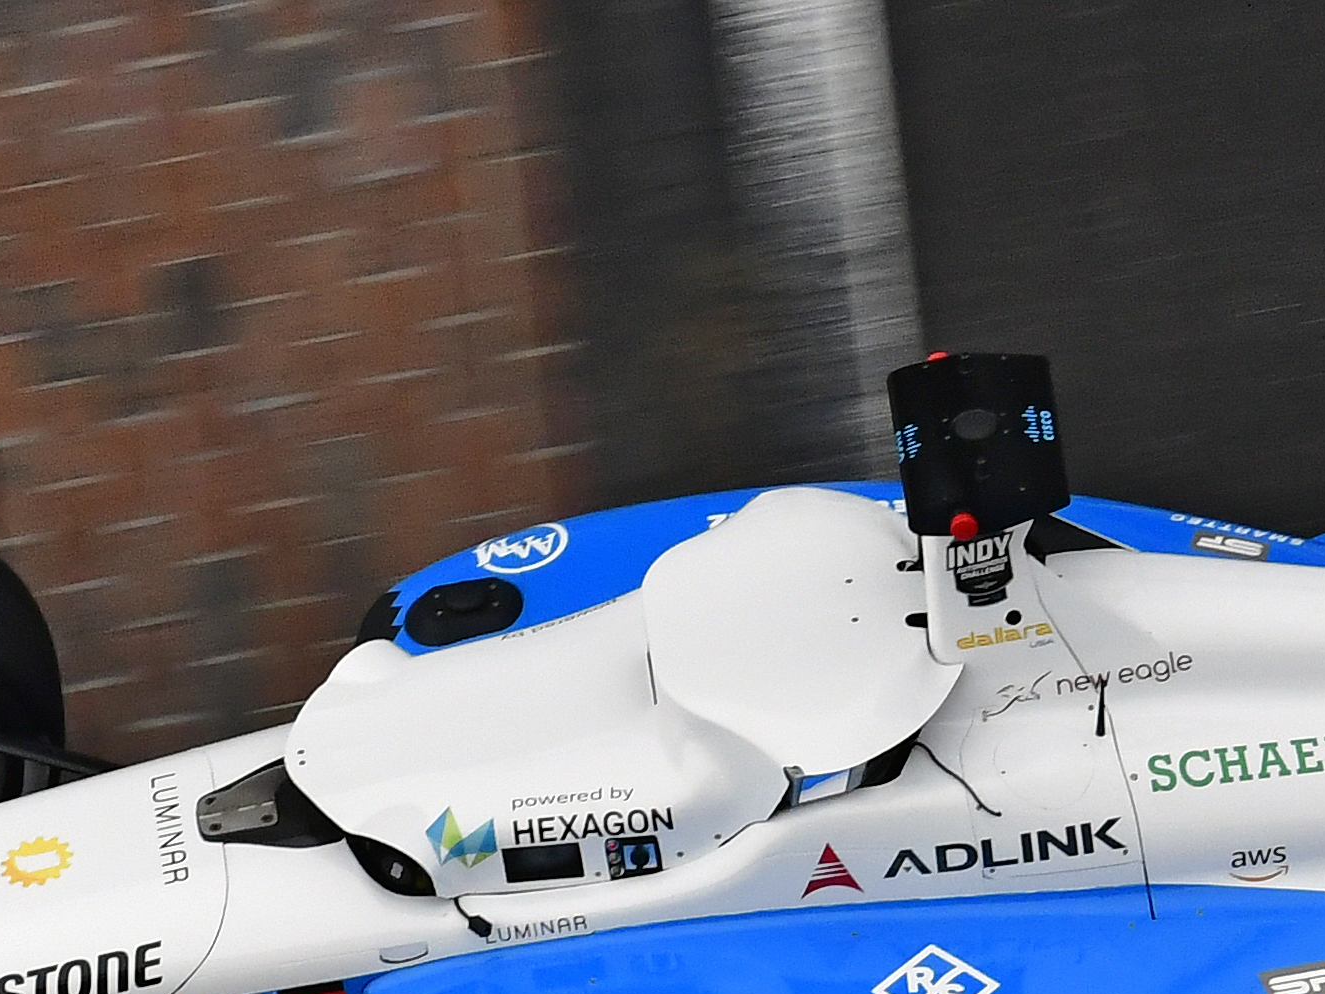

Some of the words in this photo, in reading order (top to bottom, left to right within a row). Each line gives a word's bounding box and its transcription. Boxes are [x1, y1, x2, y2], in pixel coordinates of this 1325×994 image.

[1040, 410, 1055, 441] CISCO
[948, 534, 1011, 569] INDY
[957, 622, 1053, 650] dallara
[1056, 671, 1111, 697] new
[1118, 651, 1193, 686] eagle
[511, 787, 603, 809] powered
[609, 785, 634, 803] by
[150, 773, 190, 885] LUMINAR
[513, 806, 674, 846] HEXAGON
[883, 817, 1127, 879] ADLINK
[1230, 844, 1287, 869] aws
